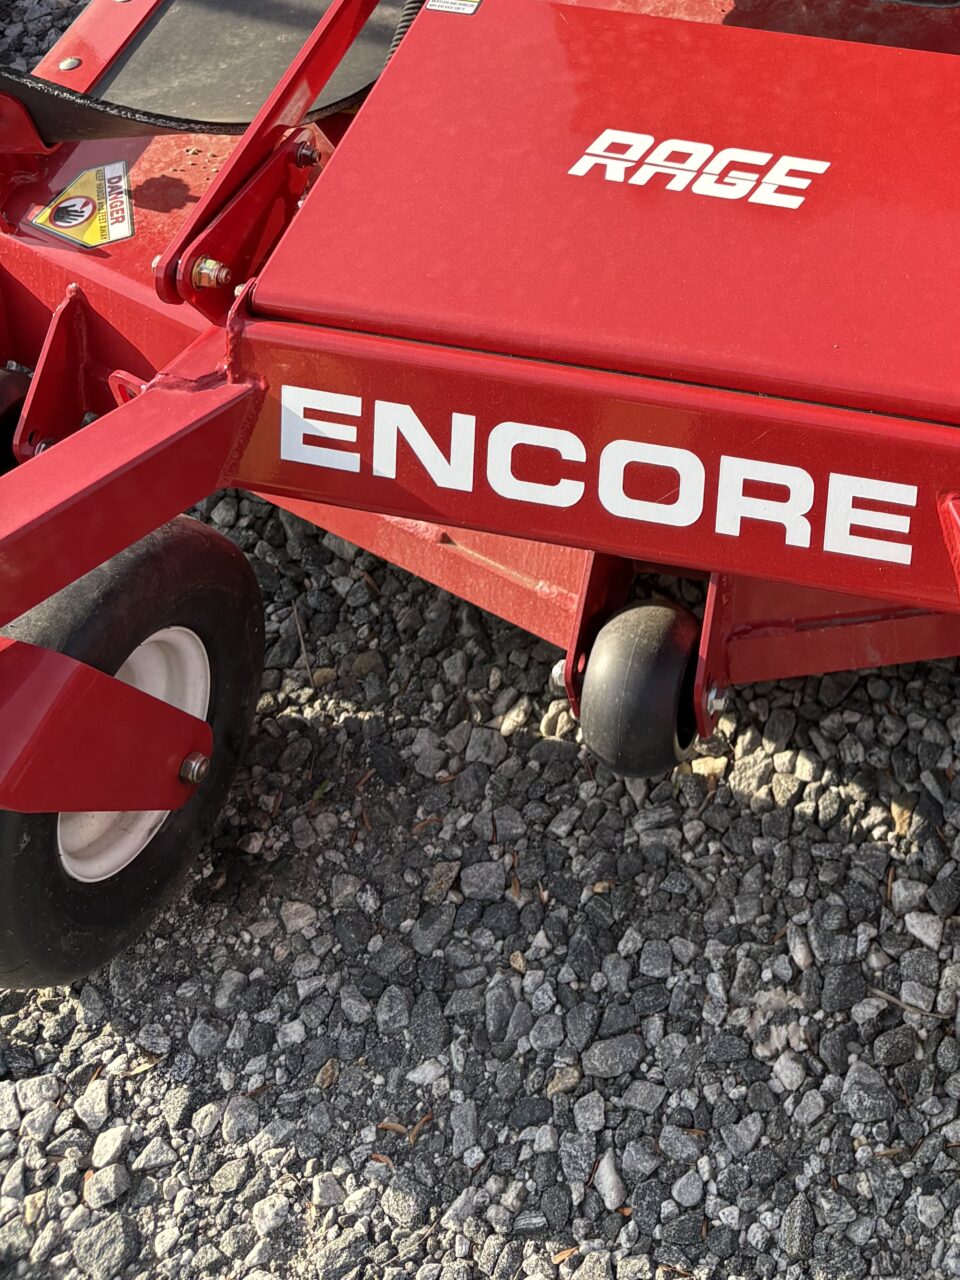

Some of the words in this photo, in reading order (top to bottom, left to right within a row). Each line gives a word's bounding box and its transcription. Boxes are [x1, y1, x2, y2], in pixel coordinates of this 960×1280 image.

[107, 174, 126, 226] DANGER
[567, 128, 831, 210] RAGE
[280, 384, 917, 565] ENCORE
